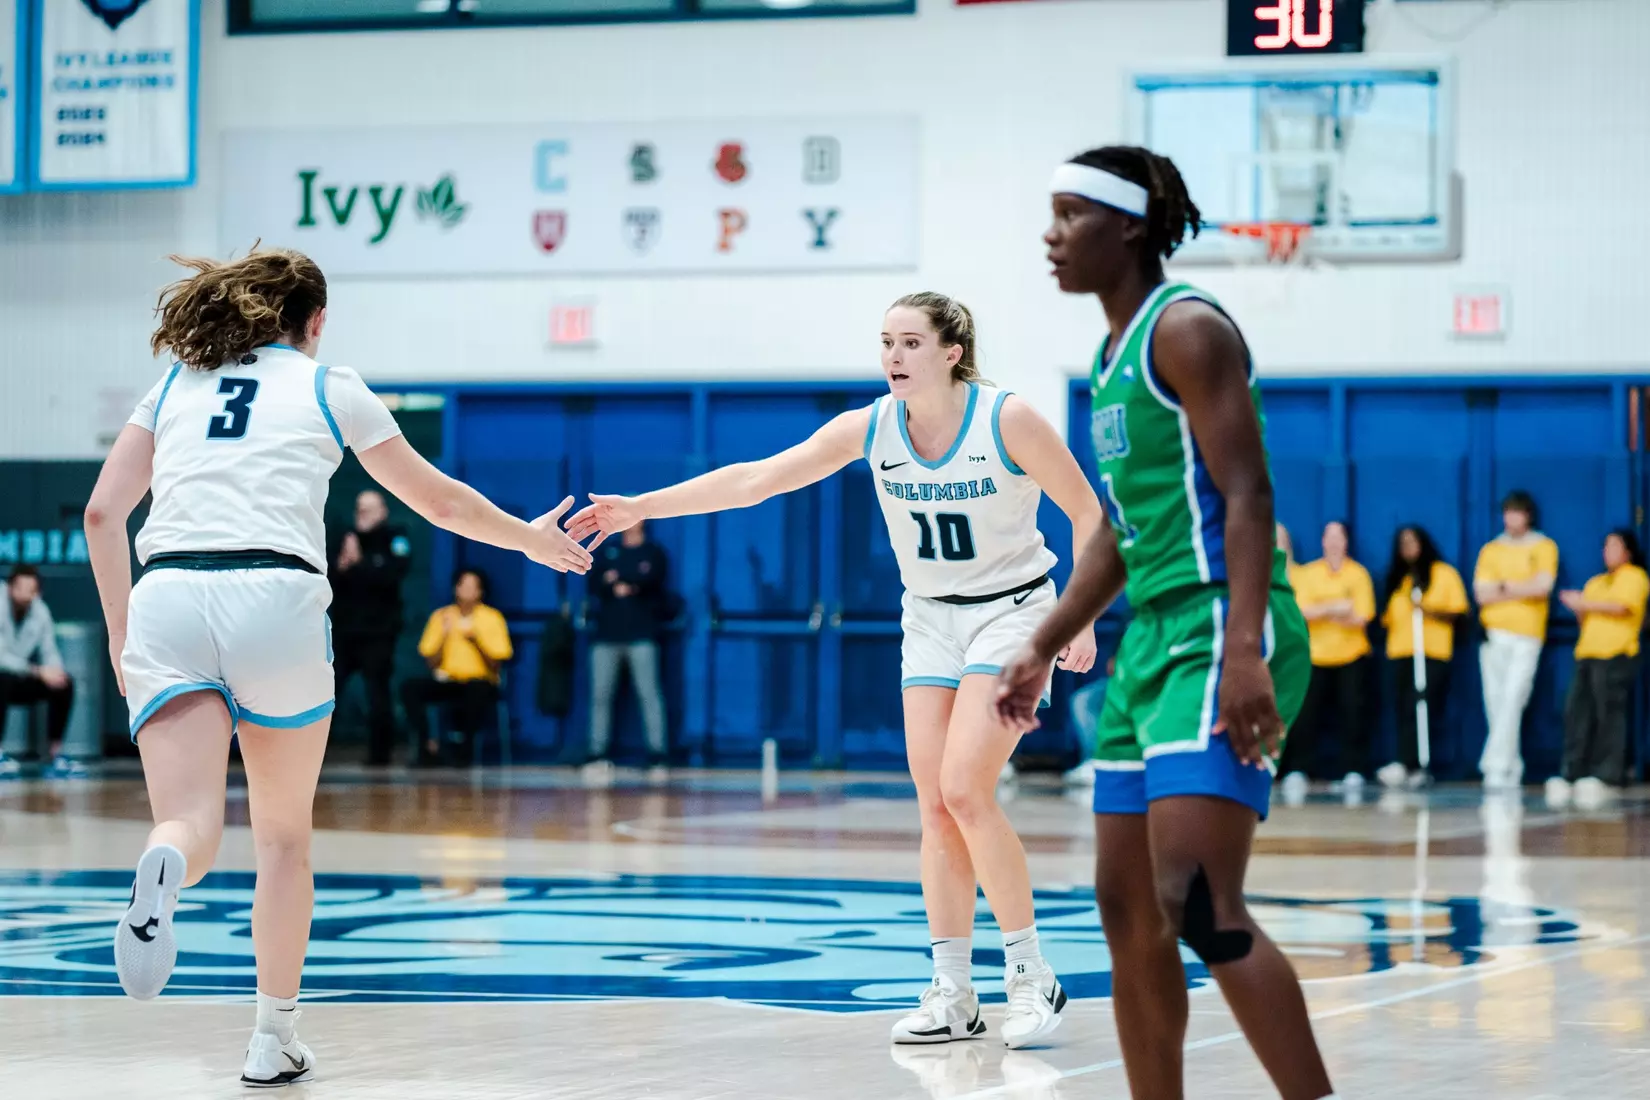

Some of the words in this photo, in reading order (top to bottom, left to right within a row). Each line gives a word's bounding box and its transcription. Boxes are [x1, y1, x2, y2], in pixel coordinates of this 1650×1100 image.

[1253, 0, 1333, 49] 30
[297, 169, 405, 245] Ivy
[801, 208, 842, 252] Y
[716, 209, 748, 254] P
[205, 376, 261, 441] 3
[968, 455, 981, 464] Ivy
[881, 477, 998, 501] COLUMBIA
[909, 509, 977, 562] 10
